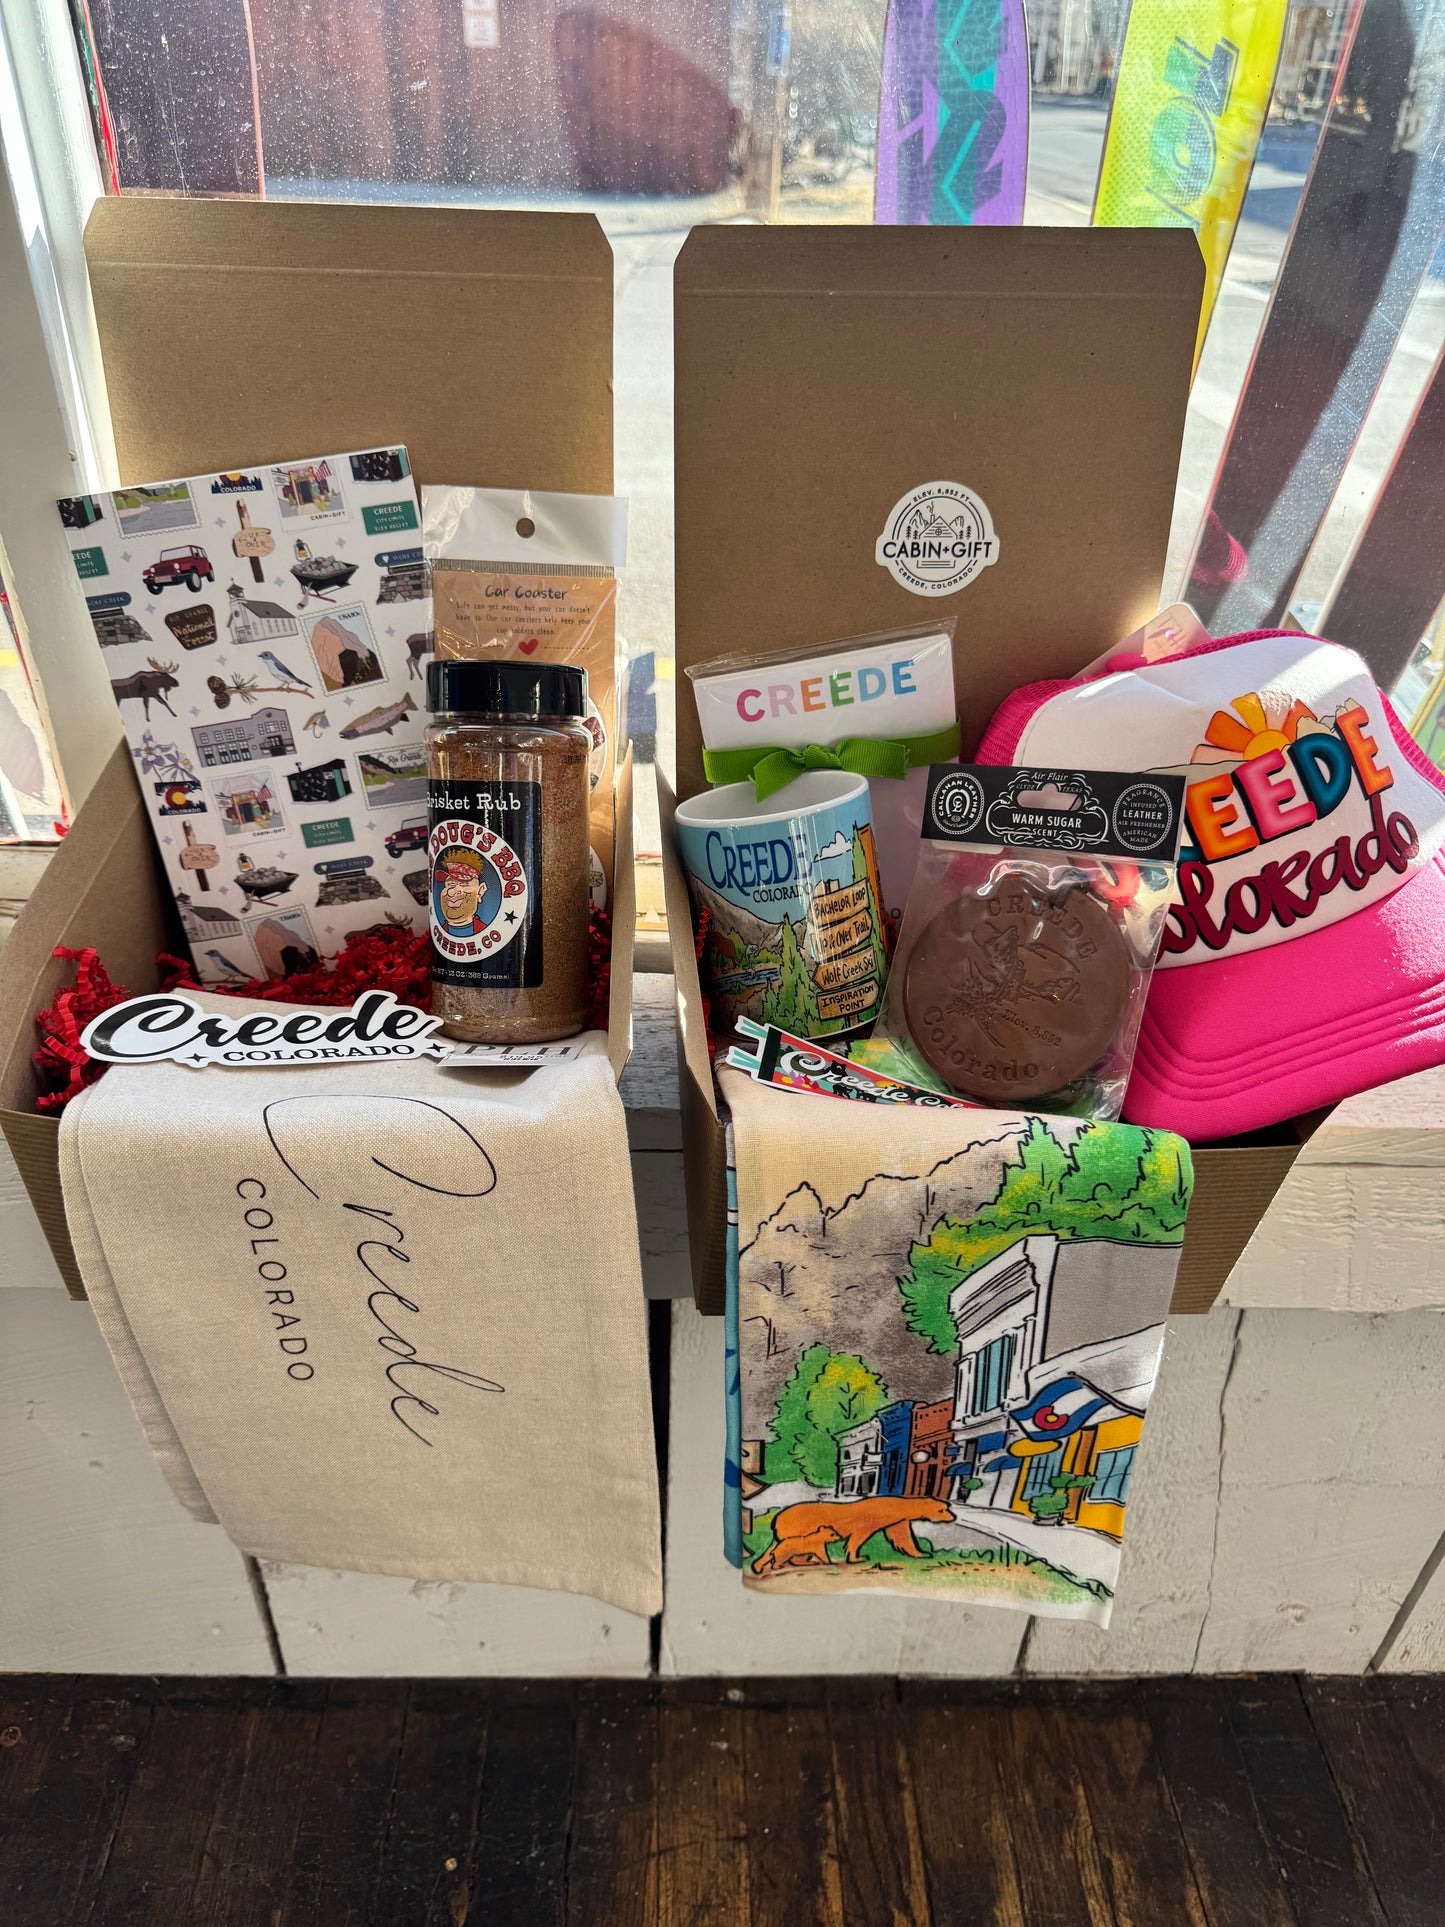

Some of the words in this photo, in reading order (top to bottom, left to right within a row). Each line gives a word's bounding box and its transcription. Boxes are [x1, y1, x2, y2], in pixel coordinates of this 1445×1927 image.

[220, 485, 257, 494] COLORADO
[913, 490, 935, 502] ELEV.
[960, 493, 970, 502] FT
[373, 506, 403, 516] CREEDE
[883, 541, 993, 560] CABIN+GIFT
[898, 567, 928, 590] CREEDE,
[931, 567, 973, 590] COLORADO
[485, 584, 509, 599] Car
[514, 586, 568, 600] Coaster
[456, 602, 470, 610] Life
[488, 604, 499, 612] get
[502, 605, 522, 613] messy,
[524, 604, 536, 612] but
[539, 606, 552, 614] your
[569, 606, 591, 614] doesn't
[173, 617, 215, 637] National
[486, 614, 499, 622] Our
[544, 616, 558, 625] help
[183, 631, 215, 648] Forest
[511, 626, 534, 635] holders
[736, 659, 917, 722] CREEDE
[1031, 772, 1046, 780] Air
[1047, 772, 1069, 781] Flair
[476, 792, 521, 811] Rub
[938, 780, 963, 817] CALLAHAN
[964, 781, 978, 819] LEATHER
[1122, 789, 1166, 808] FRAGRANCE
[168, 808, 202, 816] COLORADO
[1012, 813, 1044, 826] WARM
[1047, 816, 1082, 828] SUGAR
[1123, 809, 1163, 820] LEATHER
[312, 822, 340, 831] CREEDE
[1032, 828, 1057, 837] SCENT
[1122, 829, 1157, 839] AMERICAN
[1130, 820, 1166, 829] FRESHENER
[431, 821, 497, 856] DOUG'S
[491, 846, 525, 898] BBQ
[706, 831, 812, 896] CREEDE
[753, 883, 813, 903] COLORADO
[814, 895, 851, 920] BACHELOR
[852, 887, 866, 906] LOOP
[836, 926, 852, 946] Over
[853, 915, 870, 937] Trail
[988, 895, 1098, 960] CREEDE
[433, 925, 482, 957] CREEDE,
[482, 930, 502, 949] CO
[822, 967, 841, 986] Wolf
[842, 960, 863, 980] Creek
[864, 954, 874, 971] Ski
[822, 984, 874, 1008] INSPIRATION
[840, 999, 865, 1013] POINT
[90, 994, 437, 1057] Creede
[1001, 1009, 1029, 1031] Elev.
[1032, 1025, 1062, 1047] 8,852
[223, 1044, 415, 1062] COLORADO
[923, 1006, 1040, 1082] Colorado
[780, 1051, 910, 1102] Creede
[236, 1178, 315, 1381] COLORADO
[263, 1094, 506, 1448] Creede
